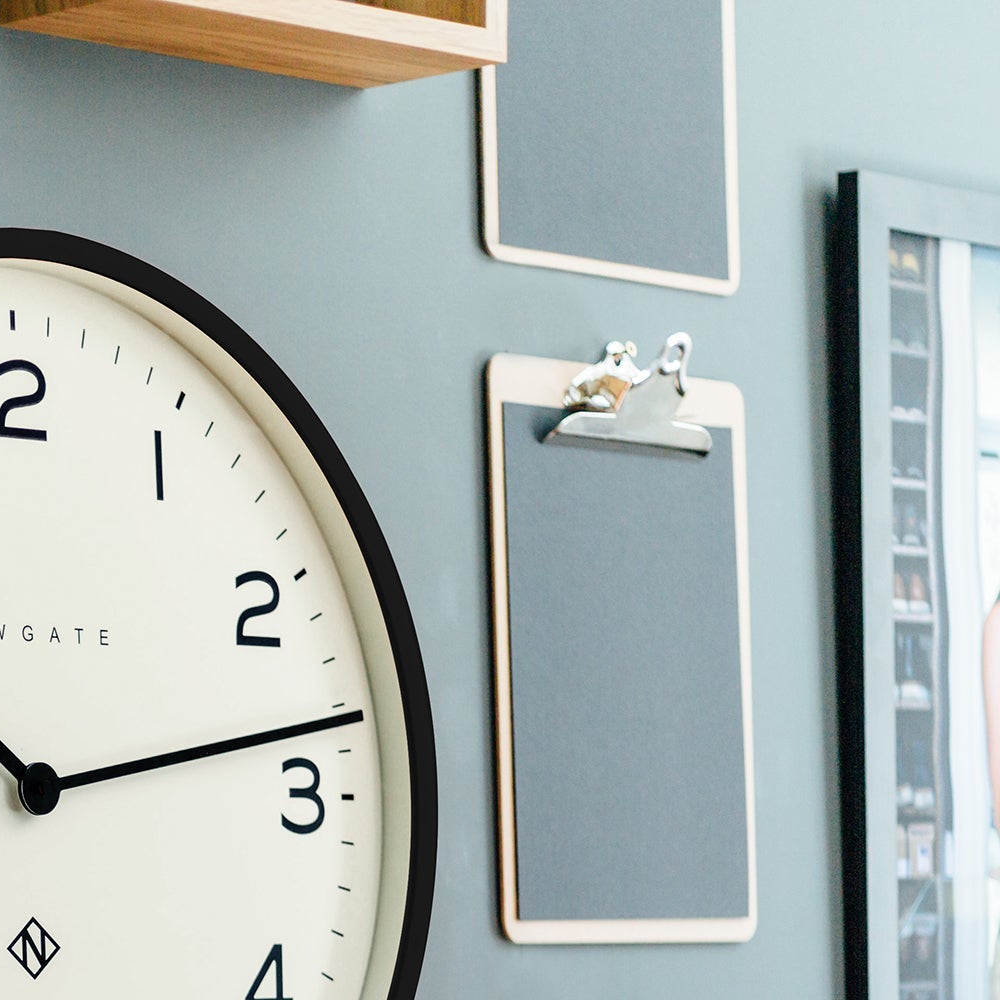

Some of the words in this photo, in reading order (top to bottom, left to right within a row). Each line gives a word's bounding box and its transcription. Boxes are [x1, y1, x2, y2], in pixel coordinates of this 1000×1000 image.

[153, 429, 164, 501] 1
[235, 570, 281, 648] 2
[281, 757, 325, 835] 3
